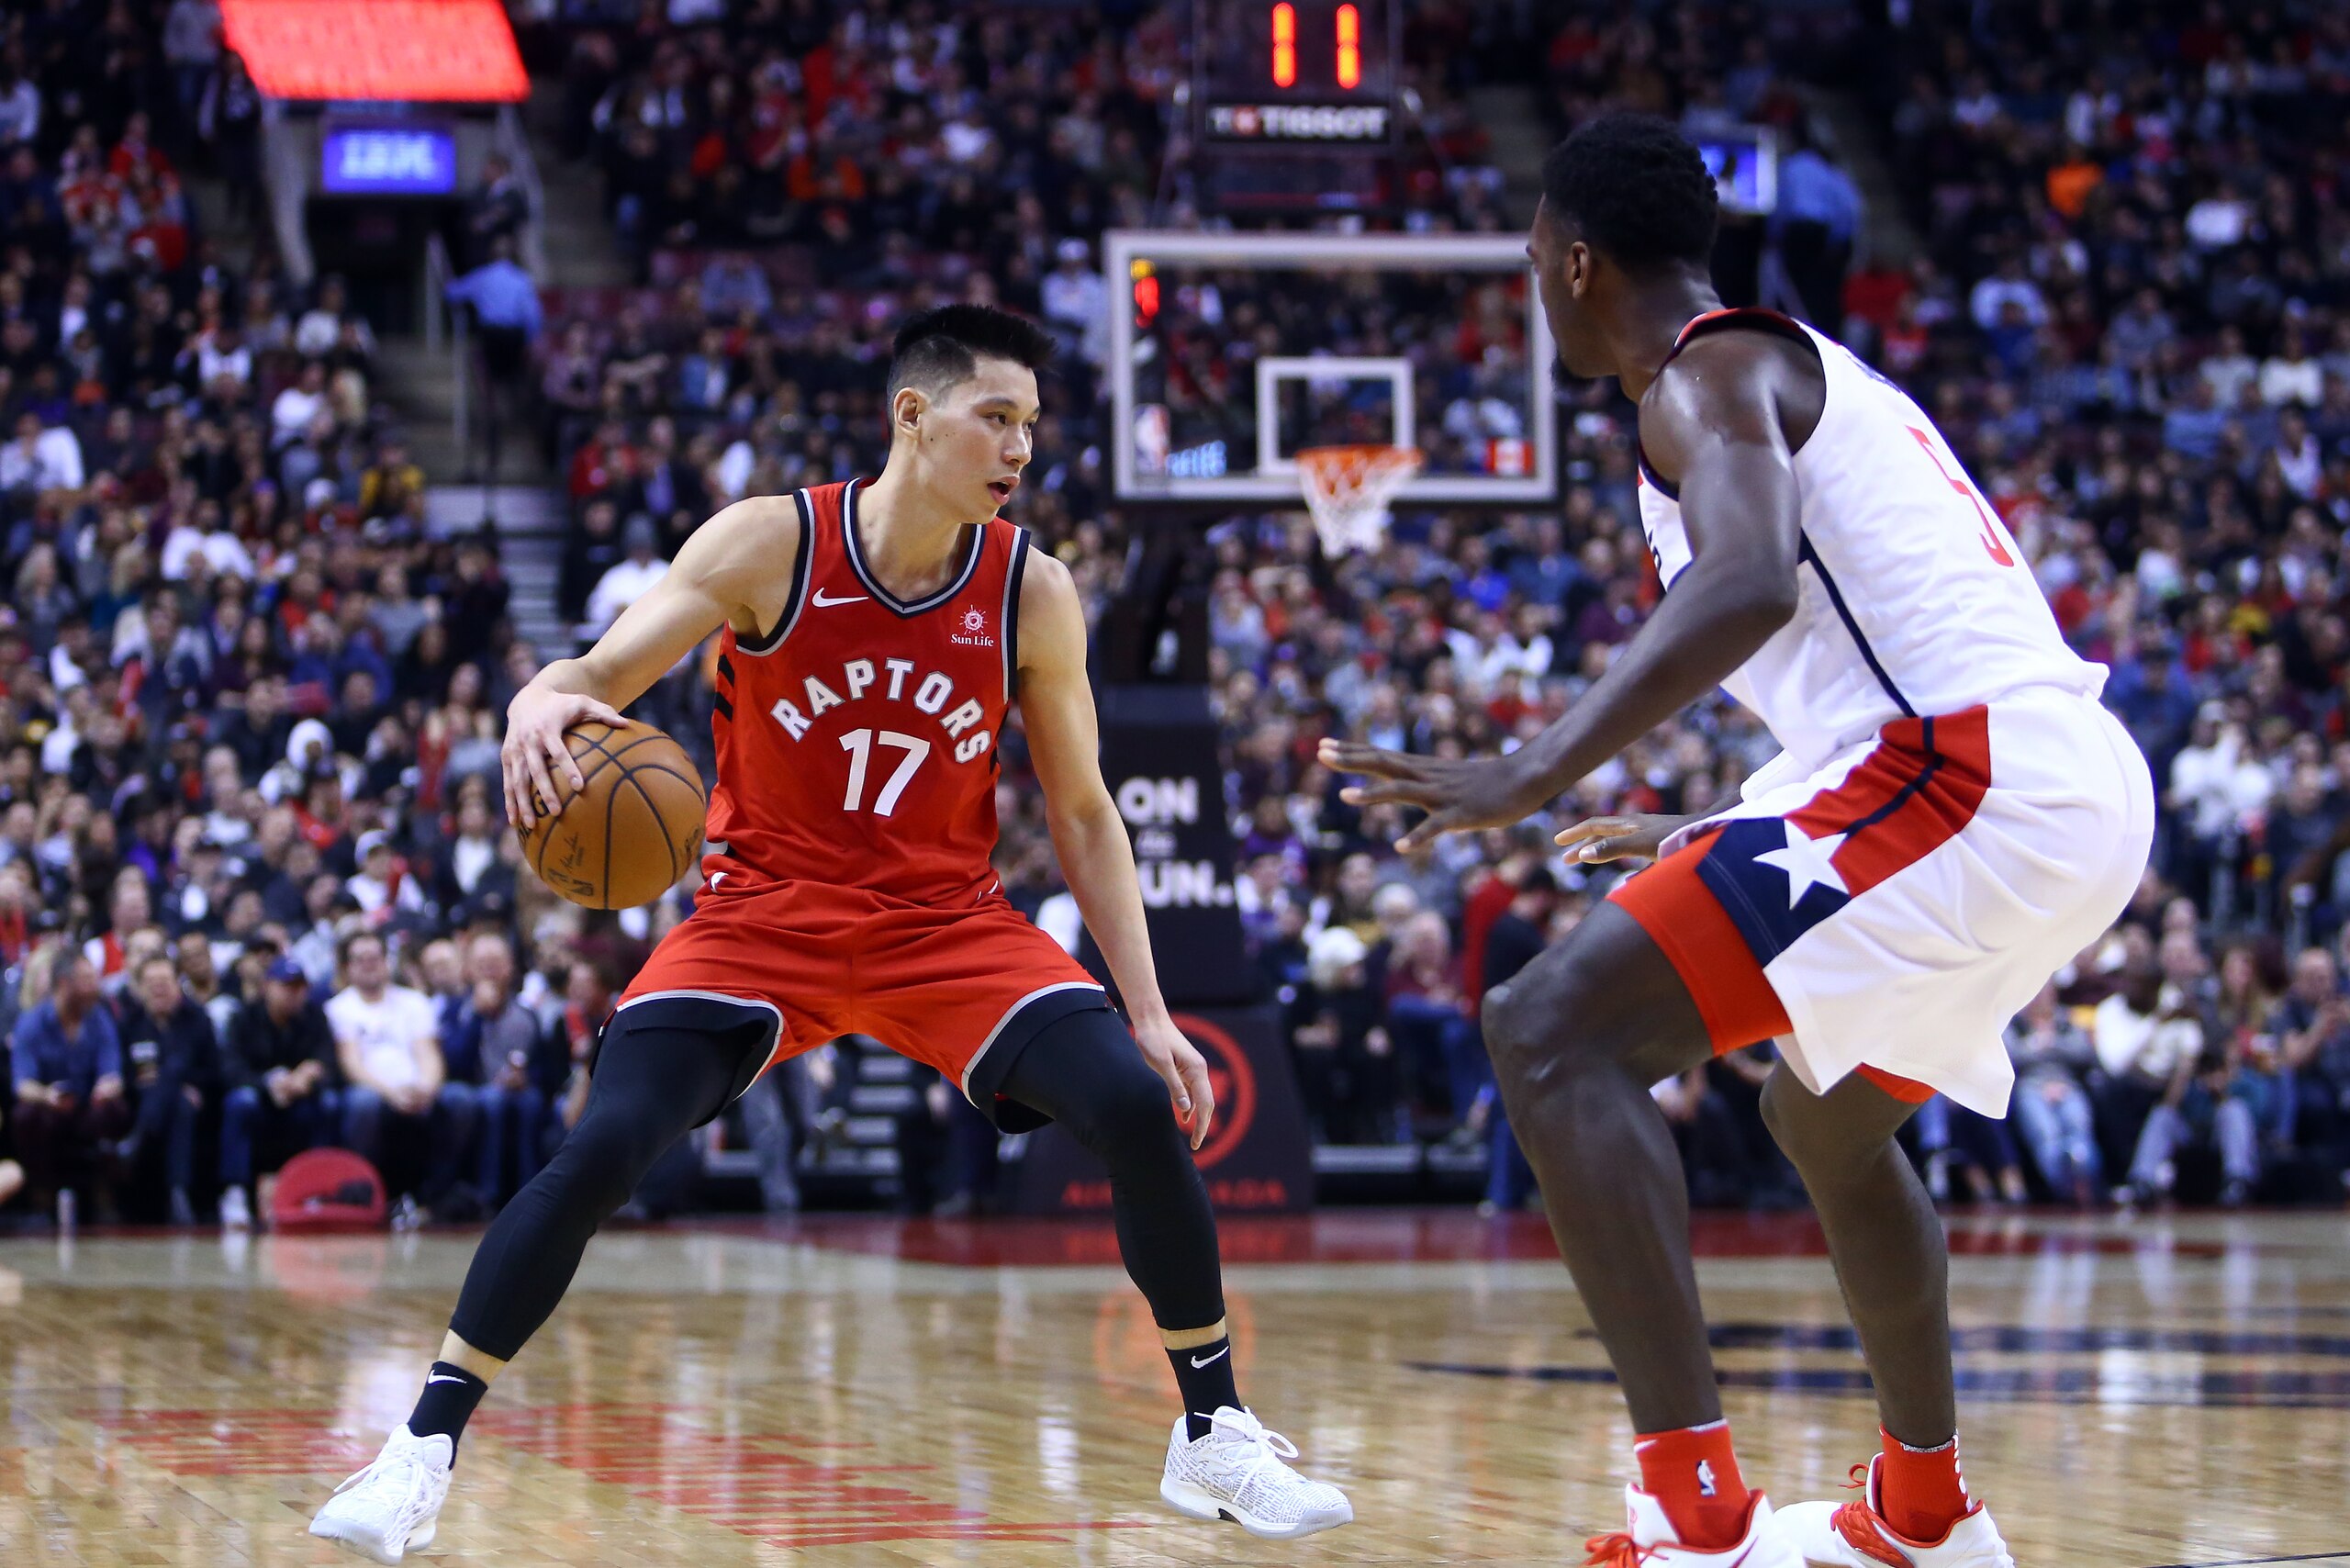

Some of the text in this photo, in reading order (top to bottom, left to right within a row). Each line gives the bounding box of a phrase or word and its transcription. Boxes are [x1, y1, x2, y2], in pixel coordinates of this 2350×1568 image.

[1272, 2, 1360, 89] 11
[1262, 106, 1385, 137] TISSOT
[951, 633, 994, 647] Sun Life
[769, 656, 991, 764] RAPTORS
[838, 728, 931, 817] 17
[1116, 776, 1200, 825] ON
[1136, 859, 1235, 909] UN.
